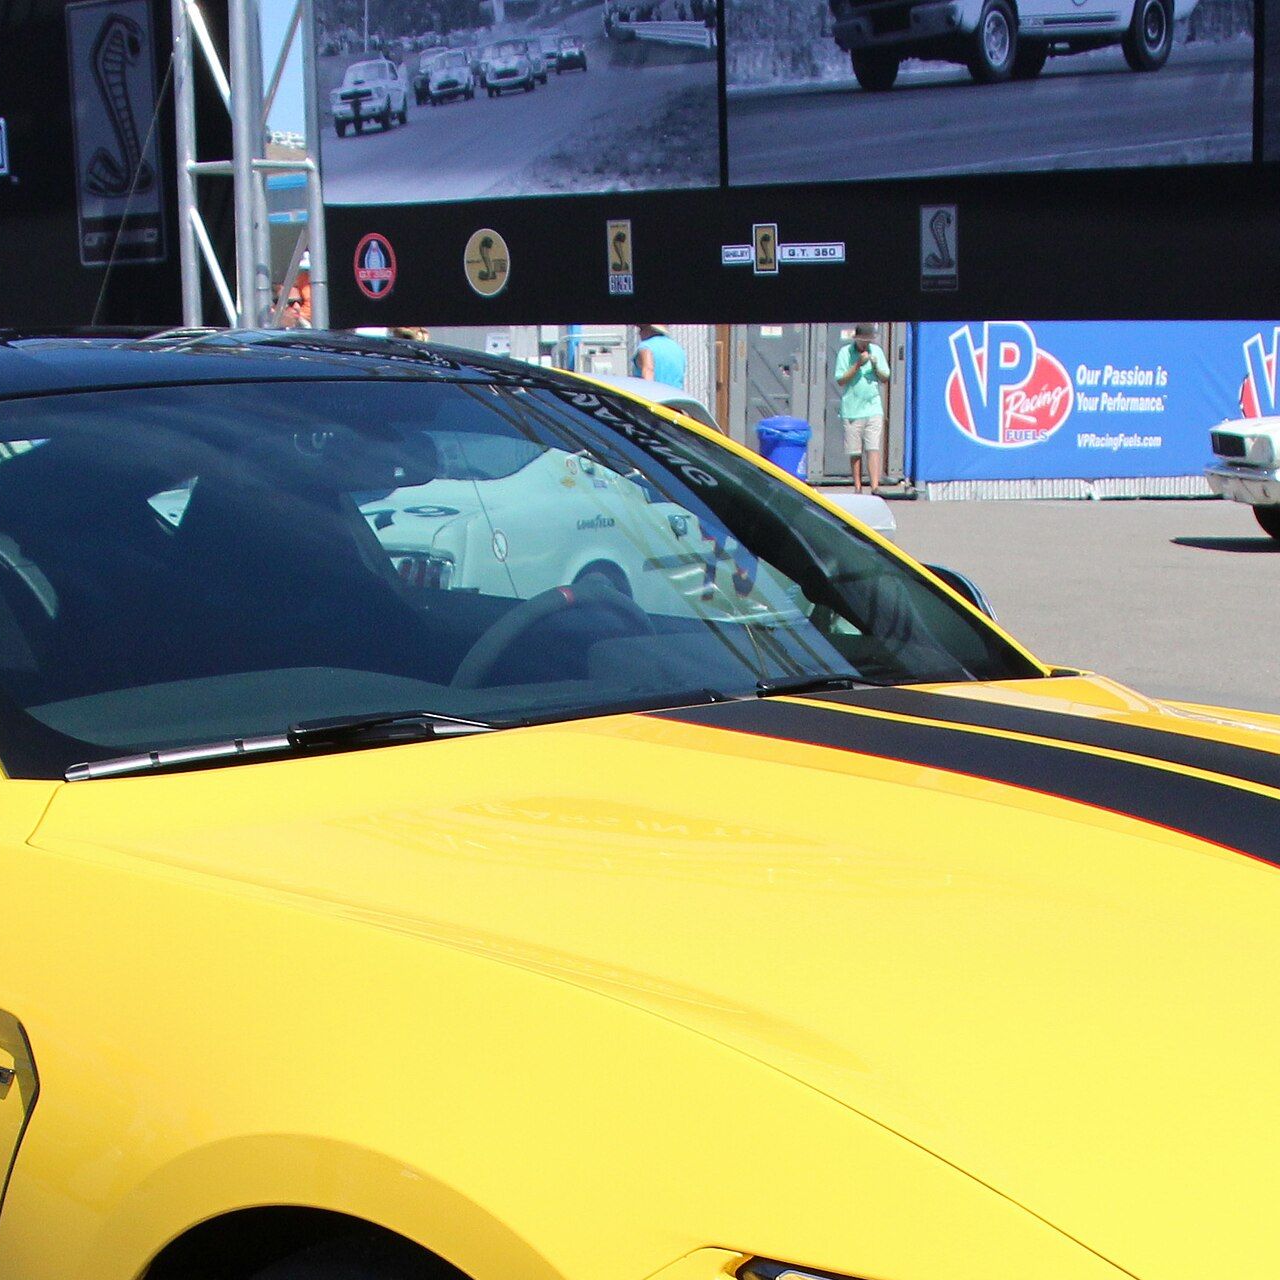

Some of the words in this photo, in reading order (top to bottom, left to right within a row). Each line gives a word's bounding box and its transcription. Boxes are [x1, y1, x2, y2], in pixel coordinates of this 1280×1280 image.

[948, 320, 1037, 445] VP
[1076, 364, 1101, 386] Our
[1103, 364, 1153, 386] Passion
[1155, 364, 1168, 385] is
[1005, 383, 1070, 428] Racing
[1076, 391, 1099, 412] Your
[1100, 391, 1165, 412] Performance.
[1006, 428, 1049, 441] FUELS
[1077, 433, 1162, 451] VPRacingFuels.com
